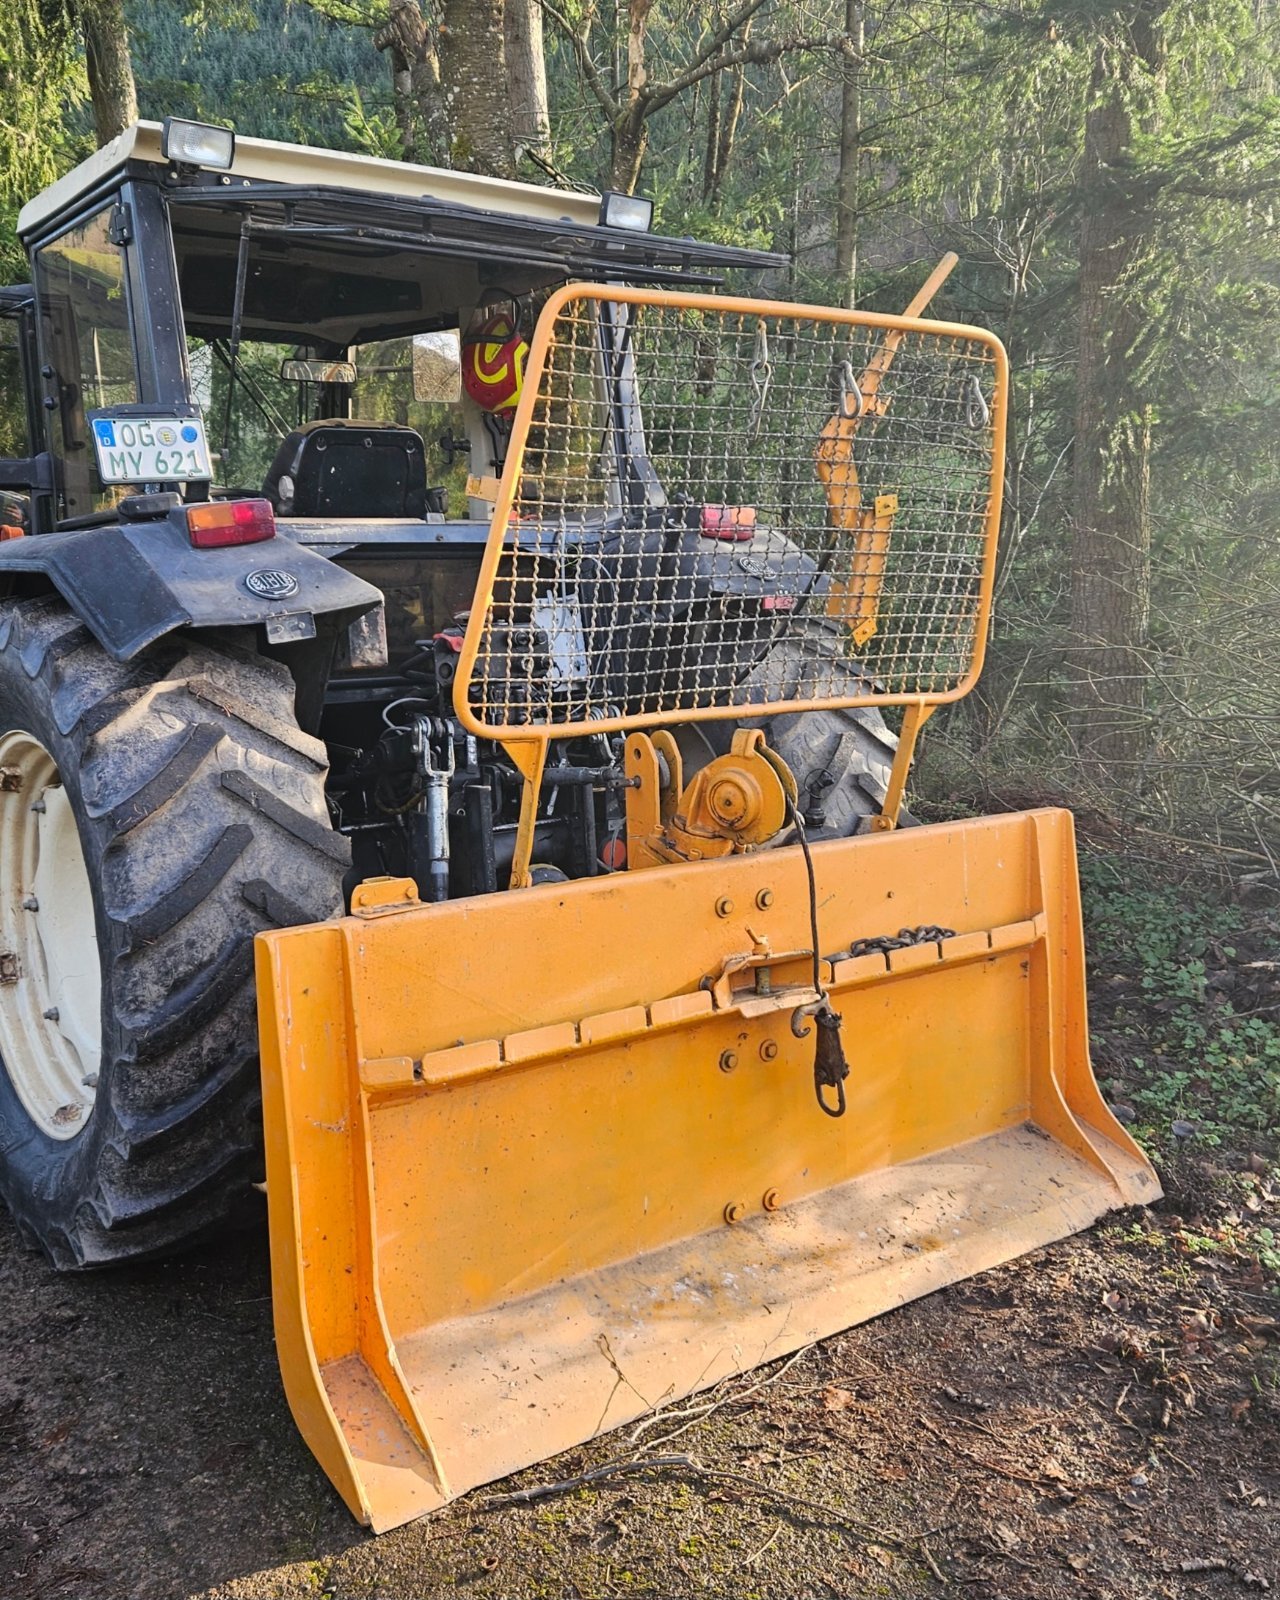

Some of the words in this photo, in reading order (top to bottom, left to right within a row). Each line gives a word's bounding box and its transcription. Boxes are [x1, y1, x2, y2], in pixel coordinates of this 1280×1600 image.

[103, 437, 111, 445] D
[121, 423, 156, 447] OG
[109, 451, 142, 476] MY
[155, 449, 203, 475] 621
